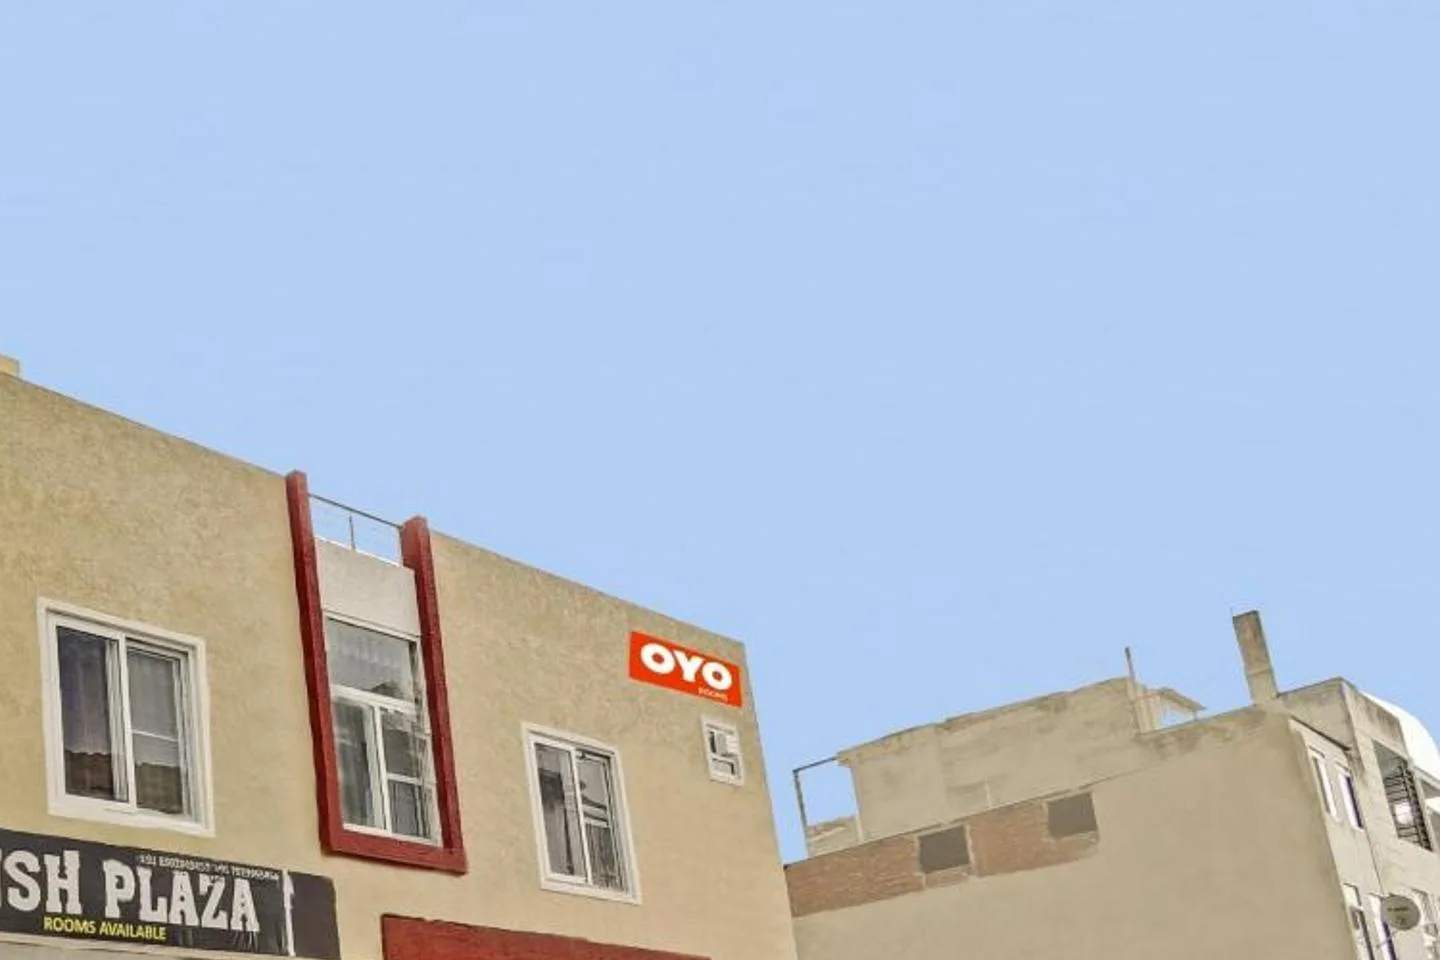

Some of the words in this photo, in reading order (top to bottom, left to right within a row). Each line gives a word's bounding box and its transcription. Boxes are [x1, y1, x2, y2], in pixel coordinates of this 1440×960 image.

[640, 643, 733, 691] OYO
[102, 858, 260, 932] PLAZA
[43, 916, 96, 934] ROOMS
[100, 921, 167, 940] AVAILABLE
